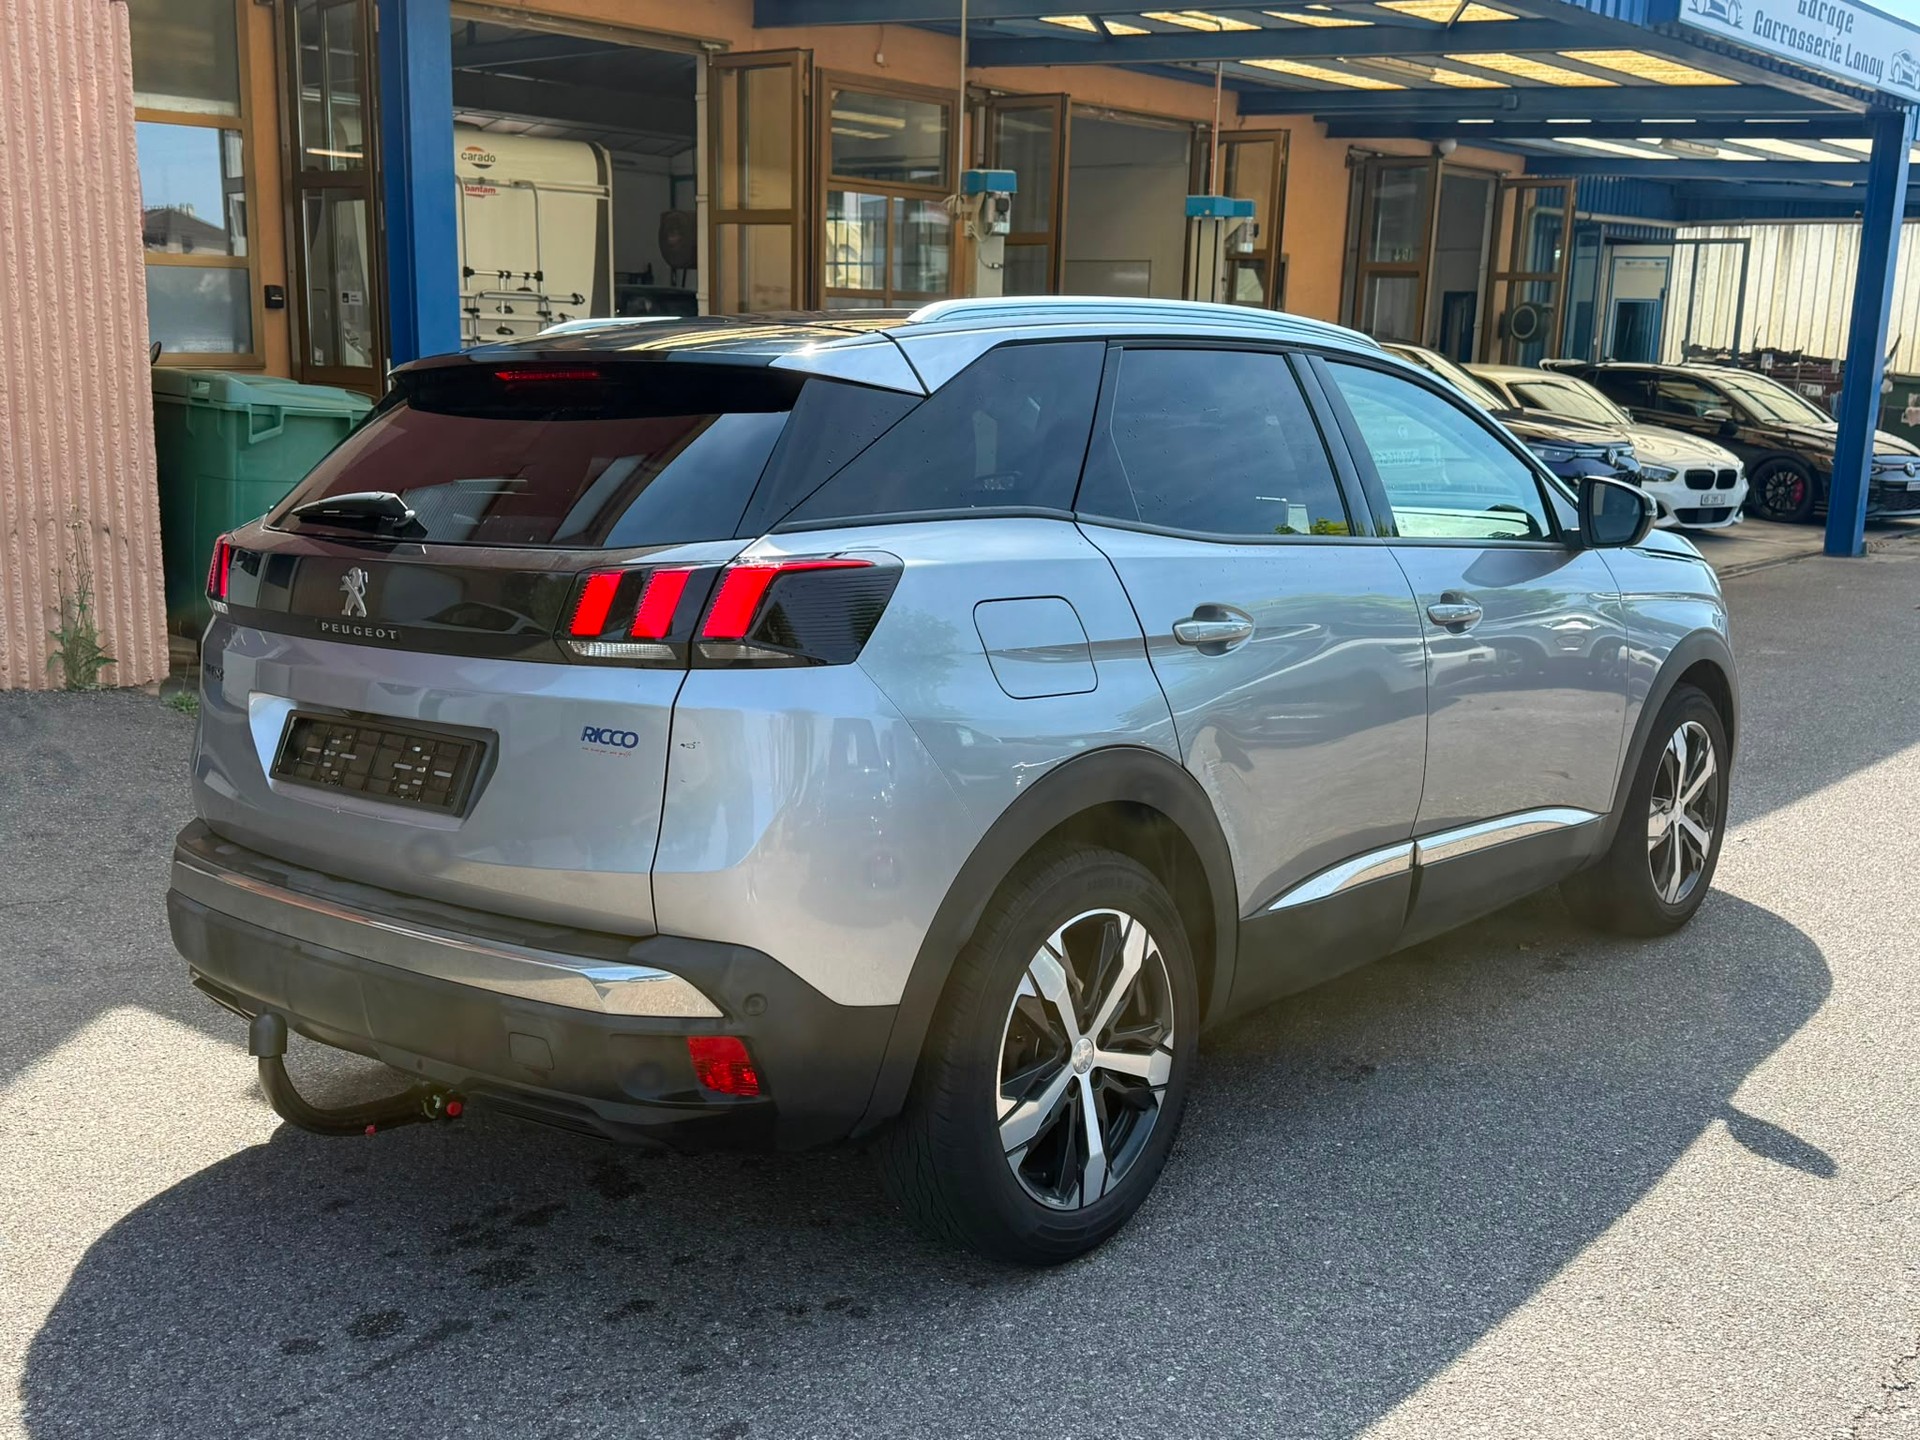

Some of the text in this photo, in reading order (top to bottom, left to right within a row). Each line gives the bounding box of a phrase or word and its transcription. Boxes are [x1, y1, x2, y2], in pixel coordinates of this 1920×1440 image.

[1797, 0, 1854, 35] Garage
[1752, 9, 1842, 63] Carrosserie
[461, 152, 496, 163] carado
[464, 184, 496, 194] bantam
[321, 622, 397, 640] PEUGEOT
[580, 726, 639, 749] RICCO
